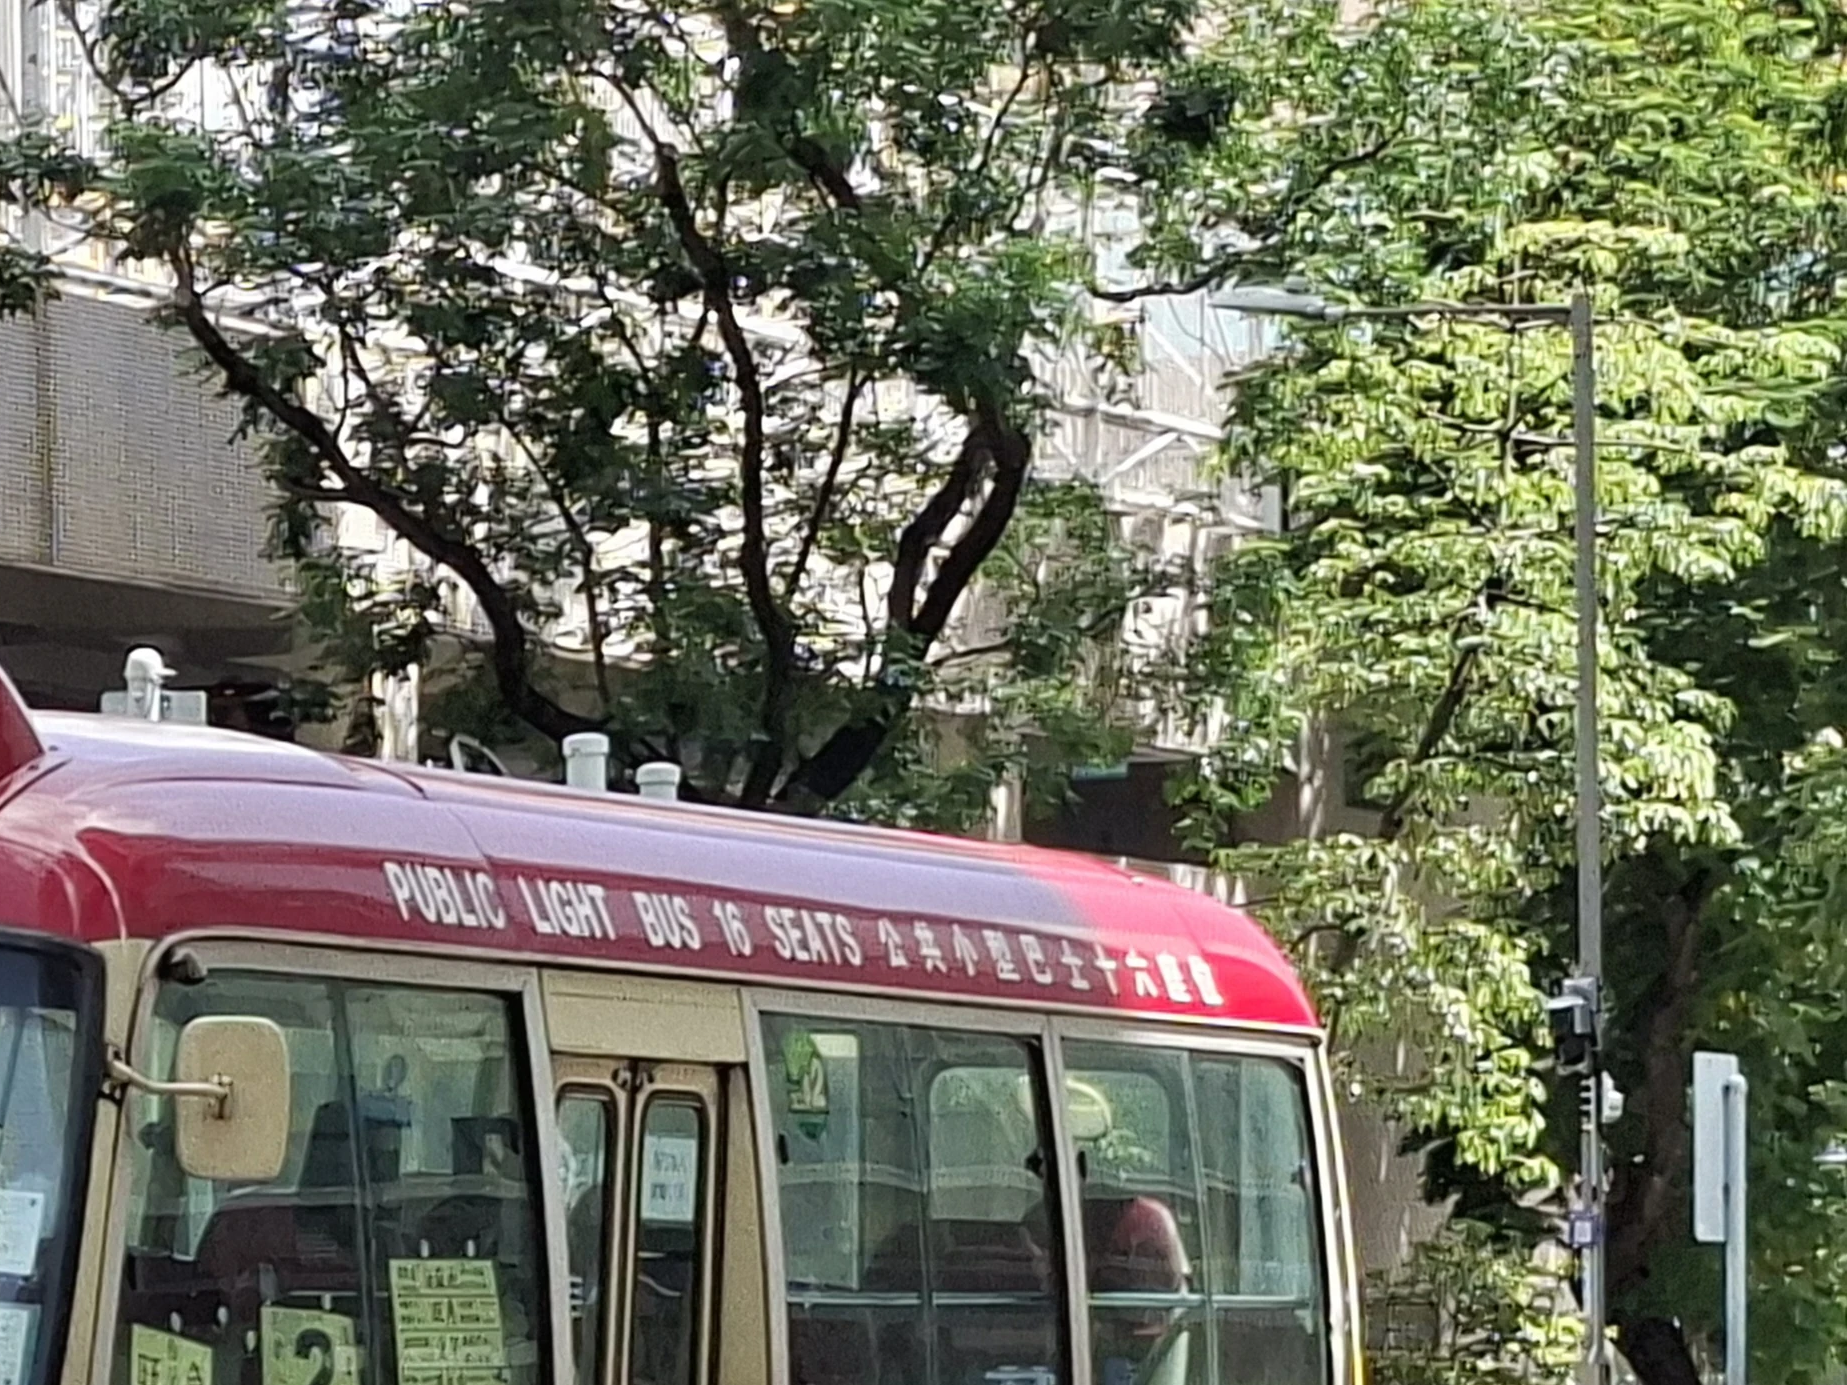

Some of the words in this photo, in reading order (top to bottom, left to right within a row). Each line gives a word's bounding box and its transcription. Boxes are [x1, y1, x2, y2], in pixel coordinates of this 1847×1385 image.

[383, 861, 506, 929] PUBLIC
[518, 875, 617, 941] LIGHT
[632, 891, 703, 950] BUS
[713, 899, 753, 957] 16
[764, 905, 863, 966] SEATS
